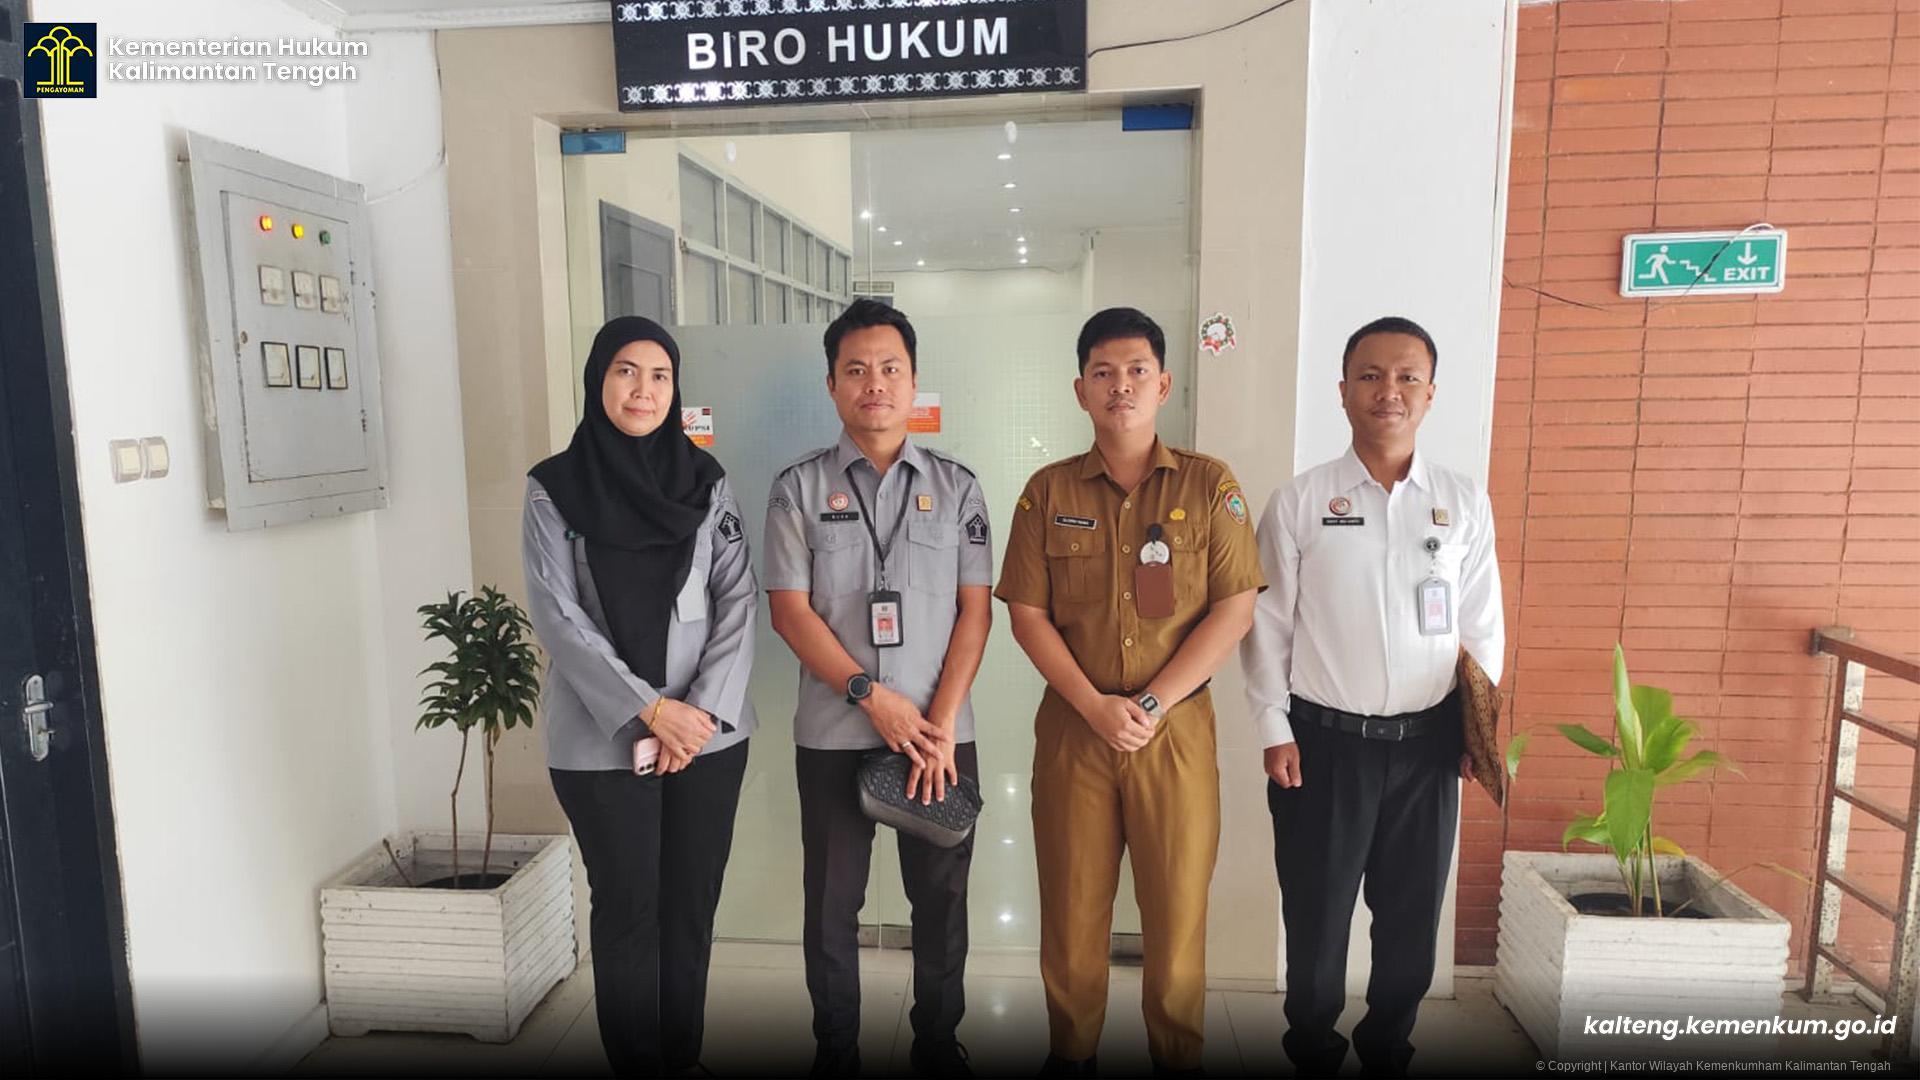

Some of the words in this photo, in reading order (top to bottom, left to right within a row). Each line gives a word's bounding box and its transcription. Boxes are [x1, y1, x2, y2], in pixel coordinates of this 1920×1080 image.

[686, 27, 806, 70] BIRO
[827, 17, 1008, 63] HUKUM
[1724, 267, 1770, 281] EXIT
